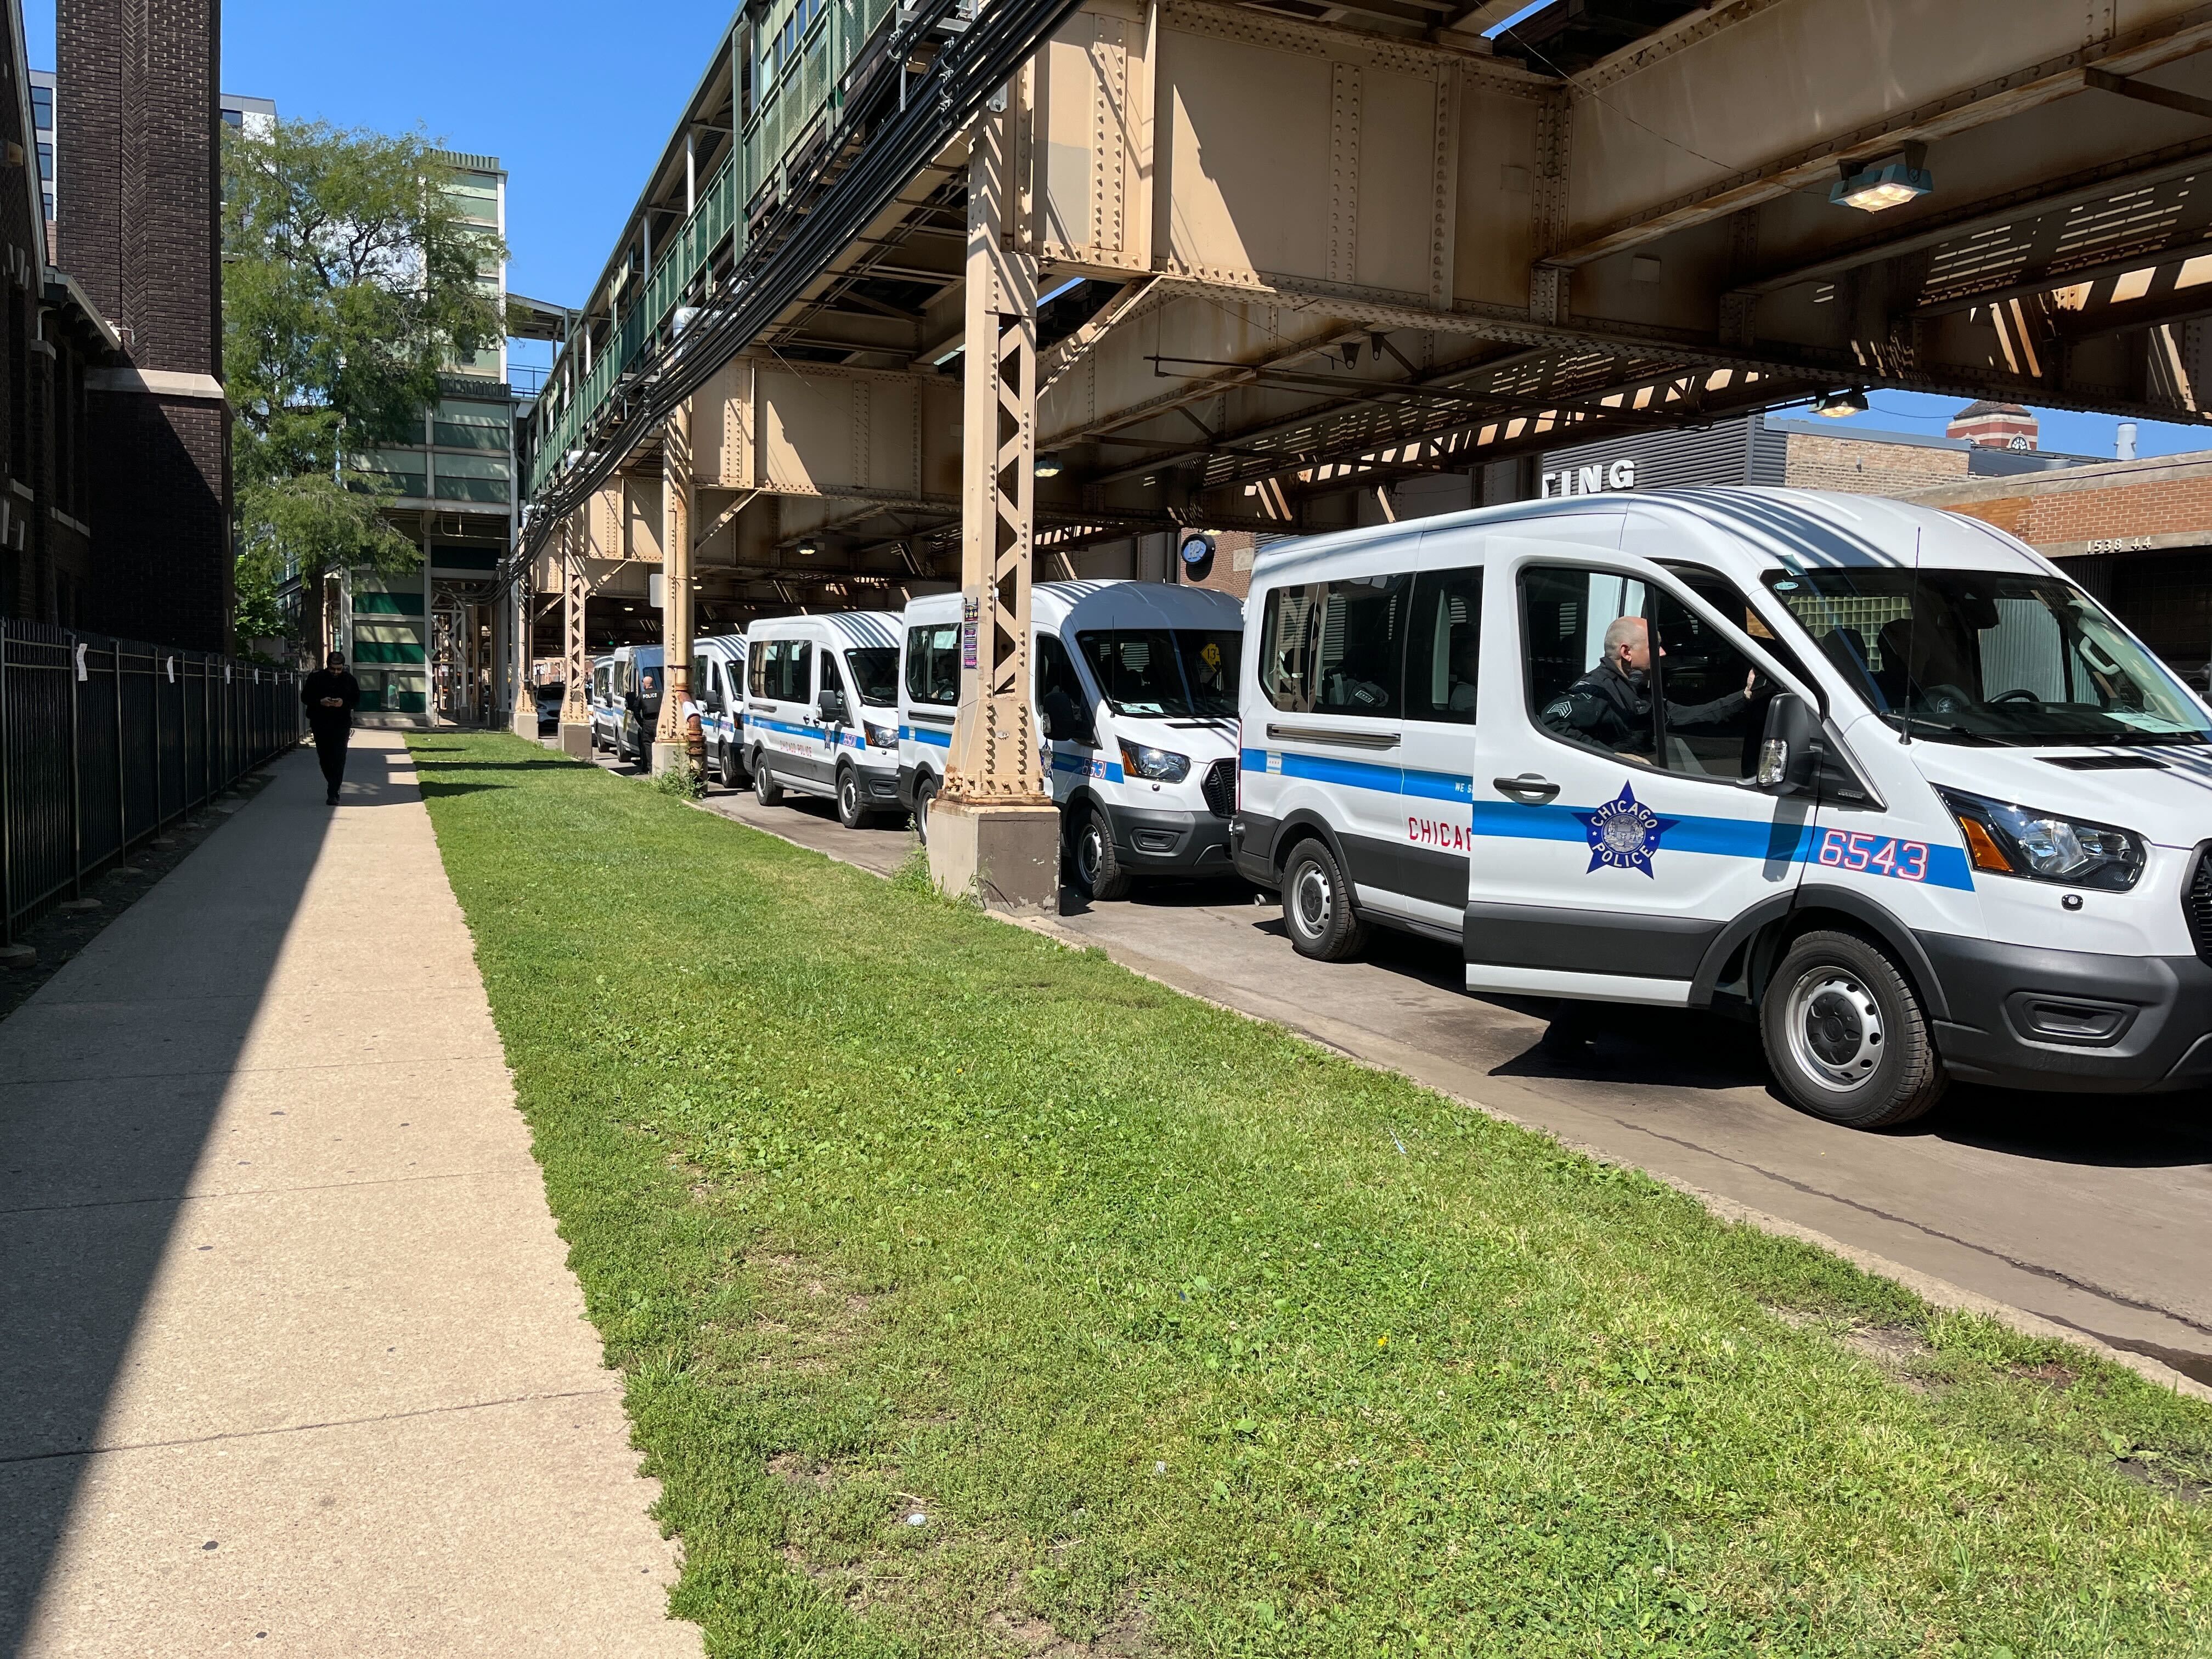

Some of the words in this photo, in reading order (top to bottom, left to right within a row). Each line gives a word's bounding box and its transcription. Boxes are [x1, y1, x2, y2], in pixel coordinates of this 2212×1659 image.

[2087, 539, 2123, 554] 1538
[2131, 536, 2152, 550] 44
[1082, 758, 1107, 779] 6531
[1455, 782, 1465, 793] WE
[1590, 800, 1658, 829] CHICAGO
[1592, 842, 1654, 867] POLICE
[1818, 828, 1929, 882] 6543
